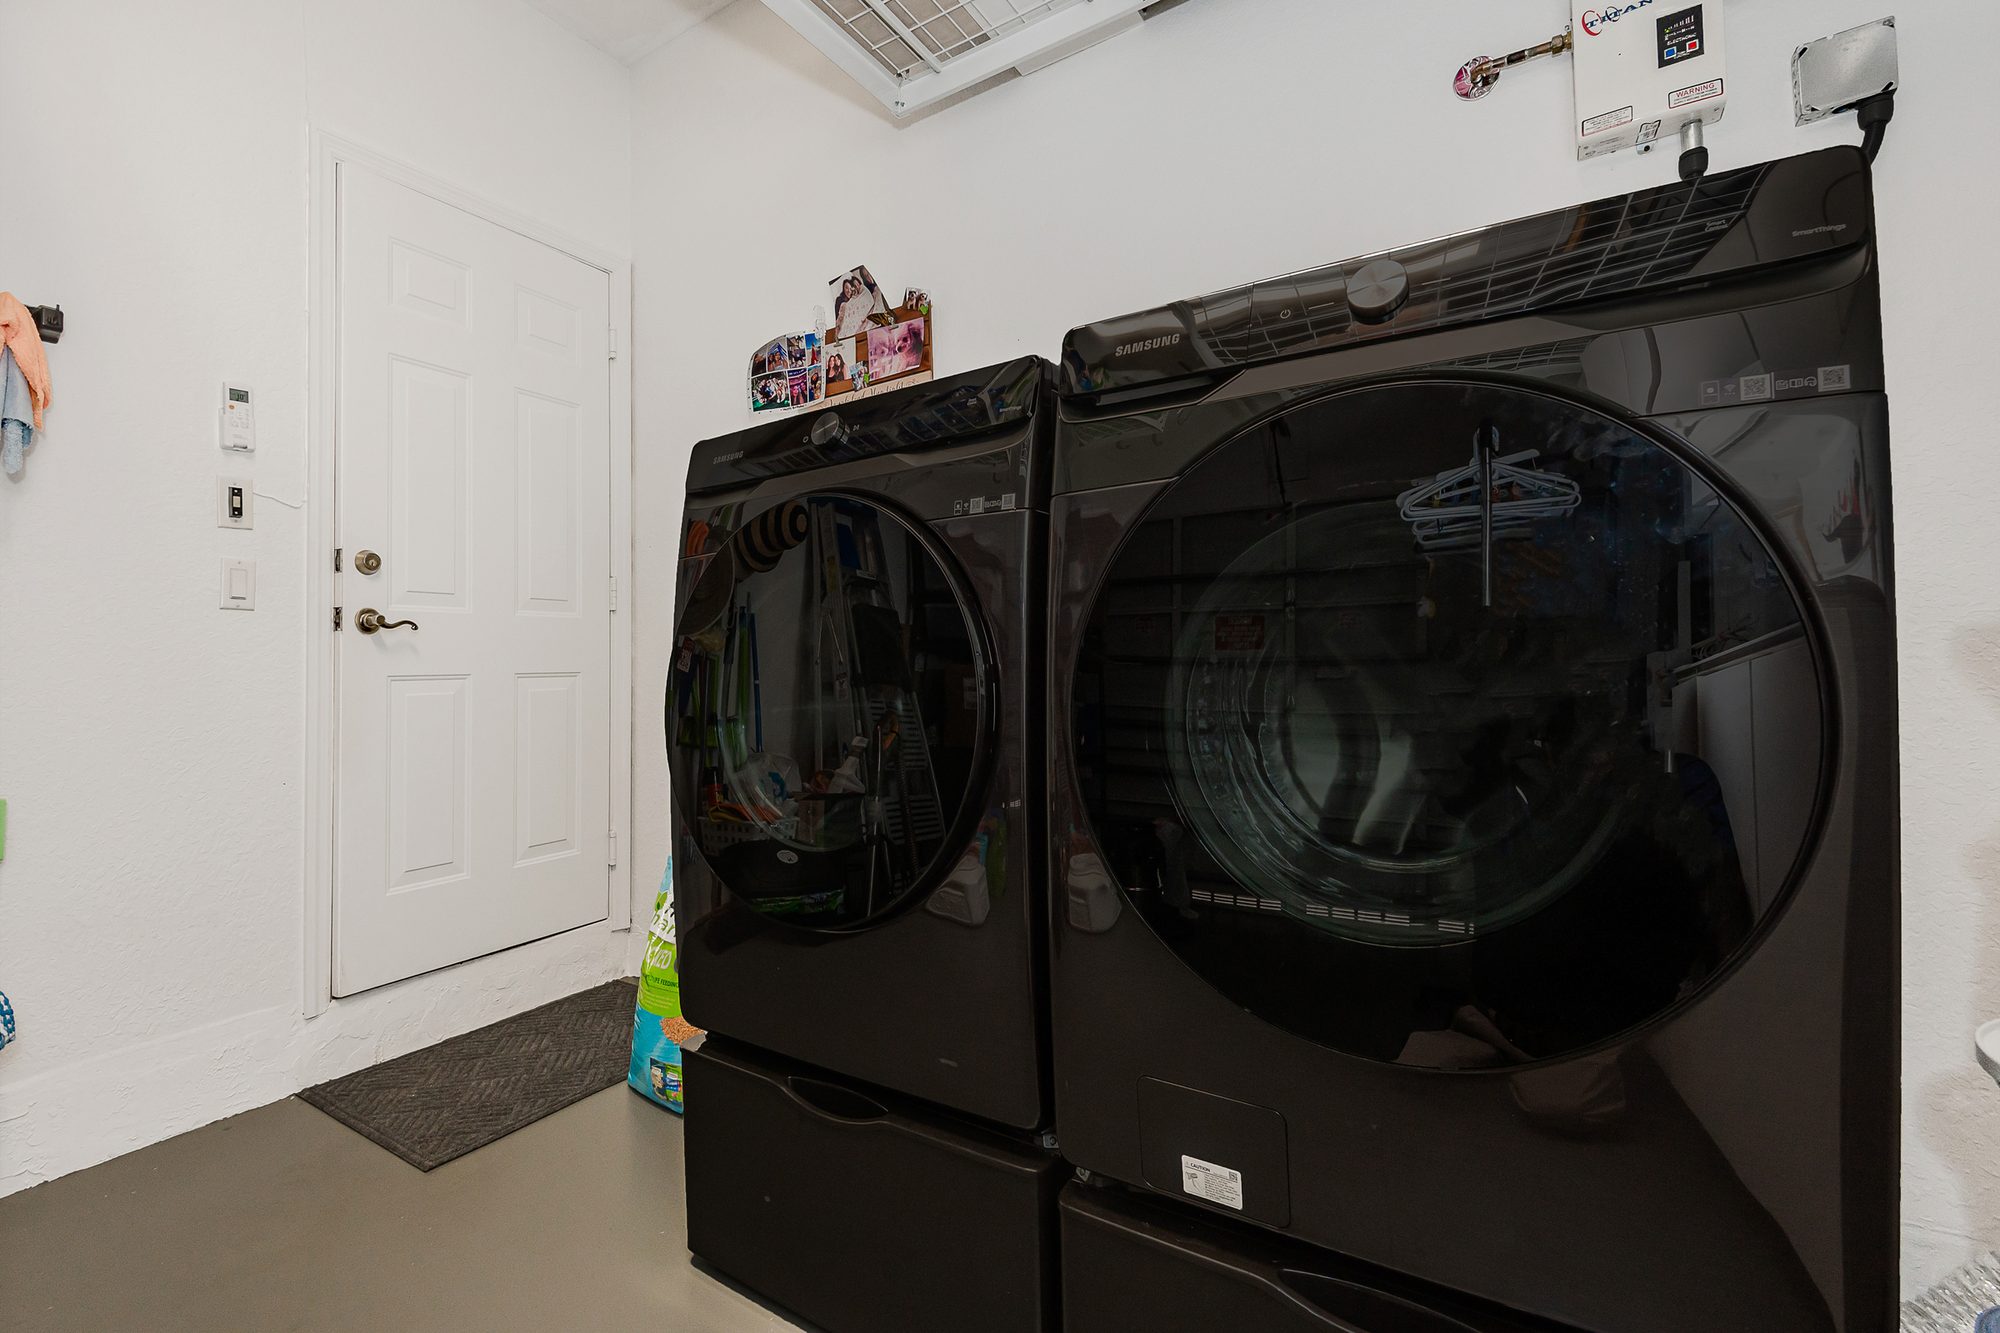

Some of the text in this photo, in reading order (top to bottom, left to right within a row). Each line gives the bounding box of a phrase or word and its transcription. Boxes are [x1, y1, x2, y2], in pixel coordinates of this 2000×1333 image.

[1675, 82, 1716, 98] WARNING
[1791, 223, 1847, 238] SmartThings
[1114, 333, 1181, 358] SAMSUNG
[712, 450, 744, 465] SAMSUNG
[1190, 1162, 1211, 1173] CAUTION
